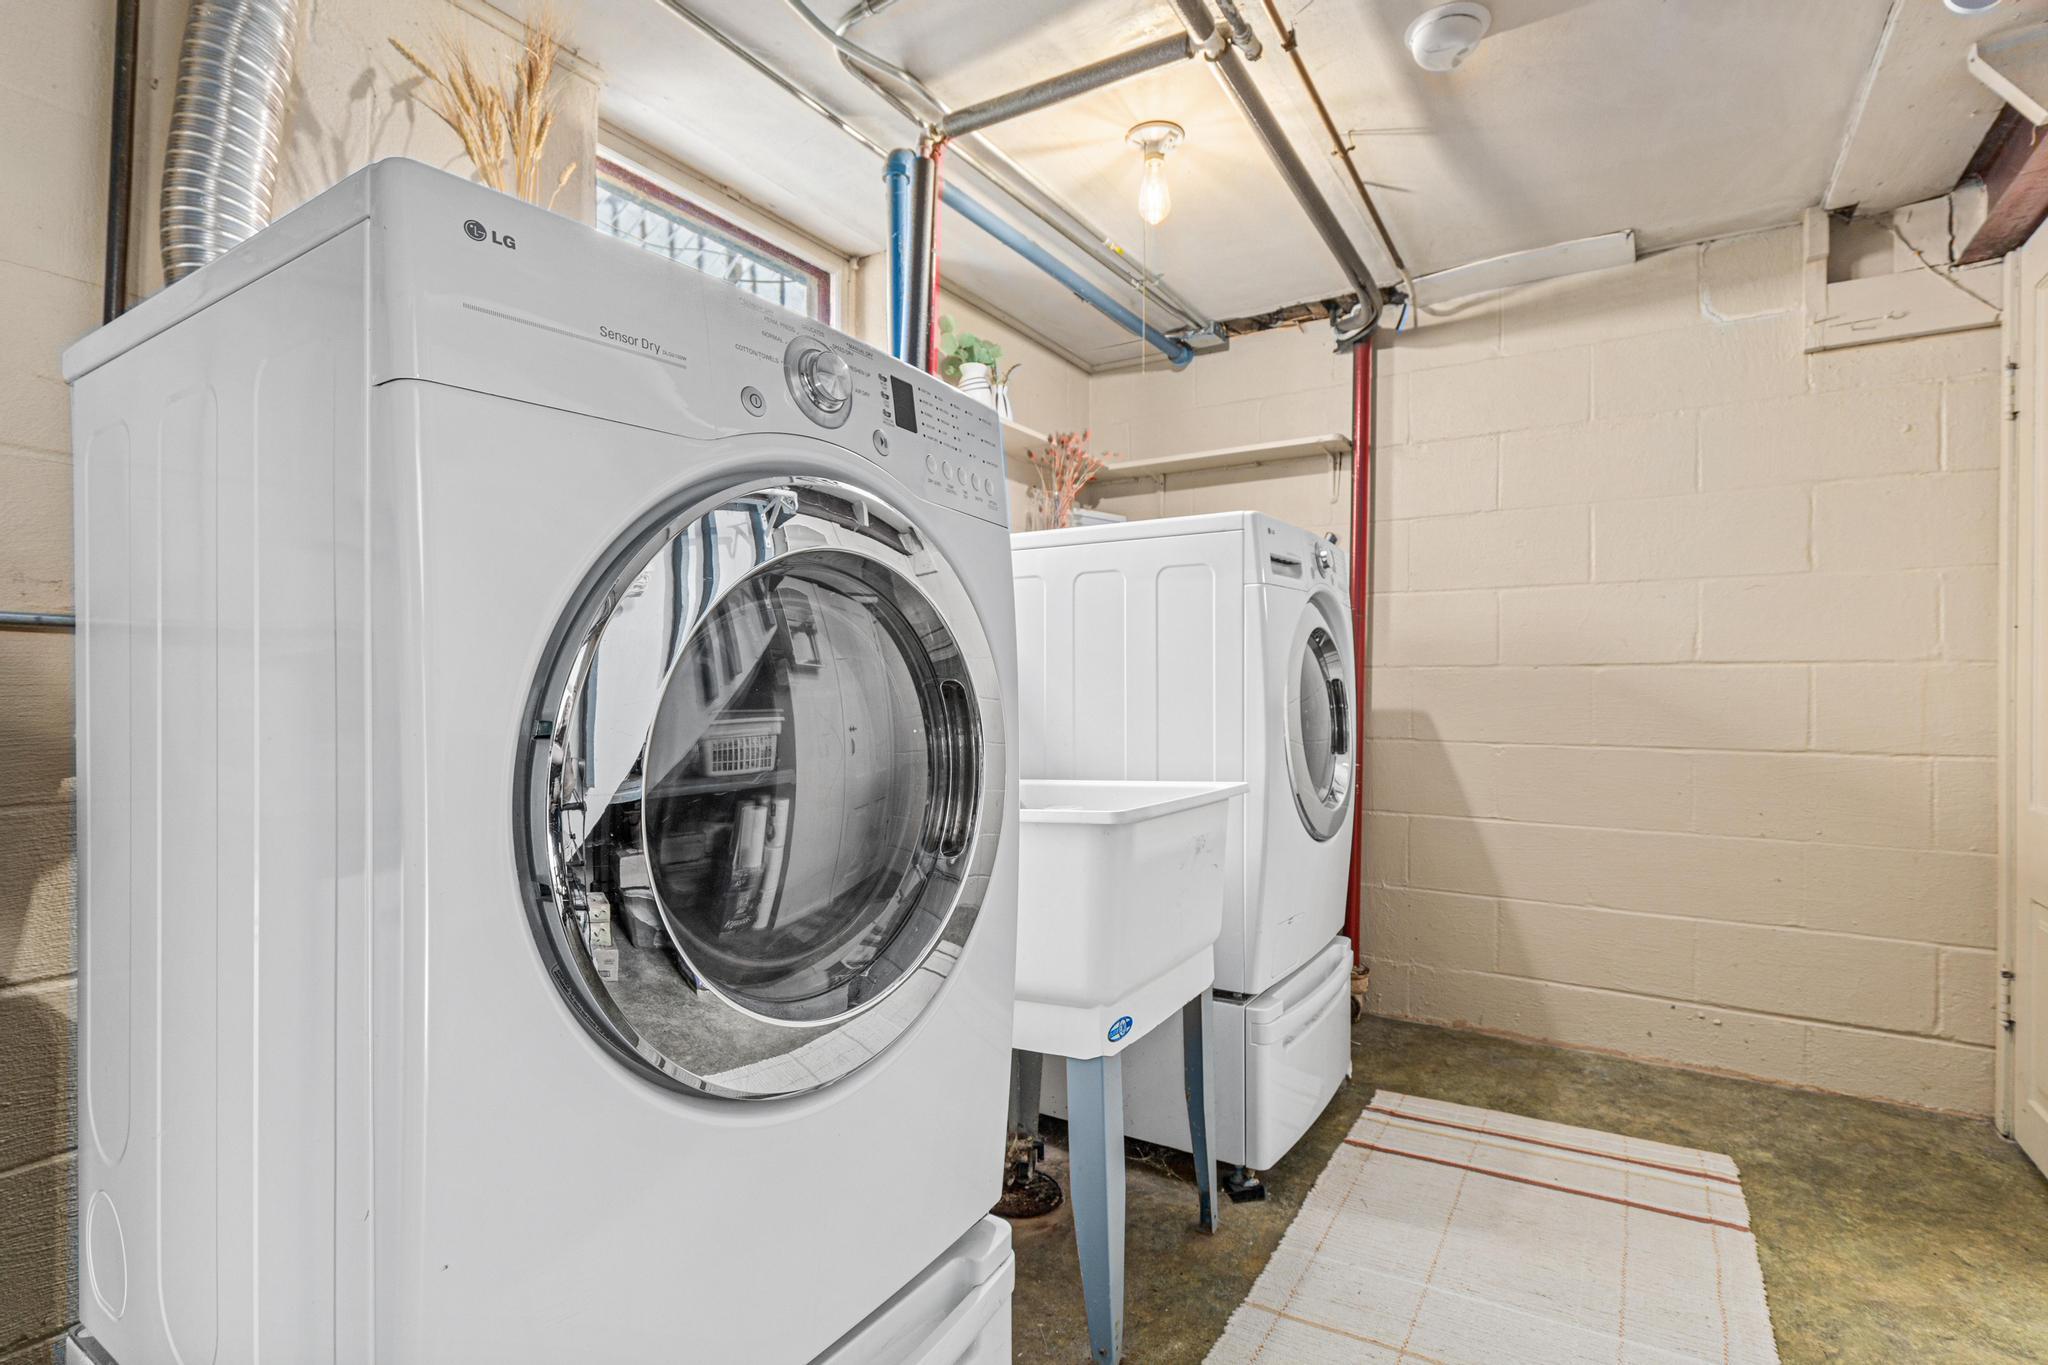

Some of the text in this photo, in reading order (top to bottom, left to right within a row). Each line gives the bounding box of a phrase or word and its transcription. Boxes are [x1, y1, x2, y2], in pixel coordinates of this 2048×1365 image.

[492, 230, 516, 250] LG
[599, 325, 638, 346] Sensor
[641, 338, 661, 355] Dry
